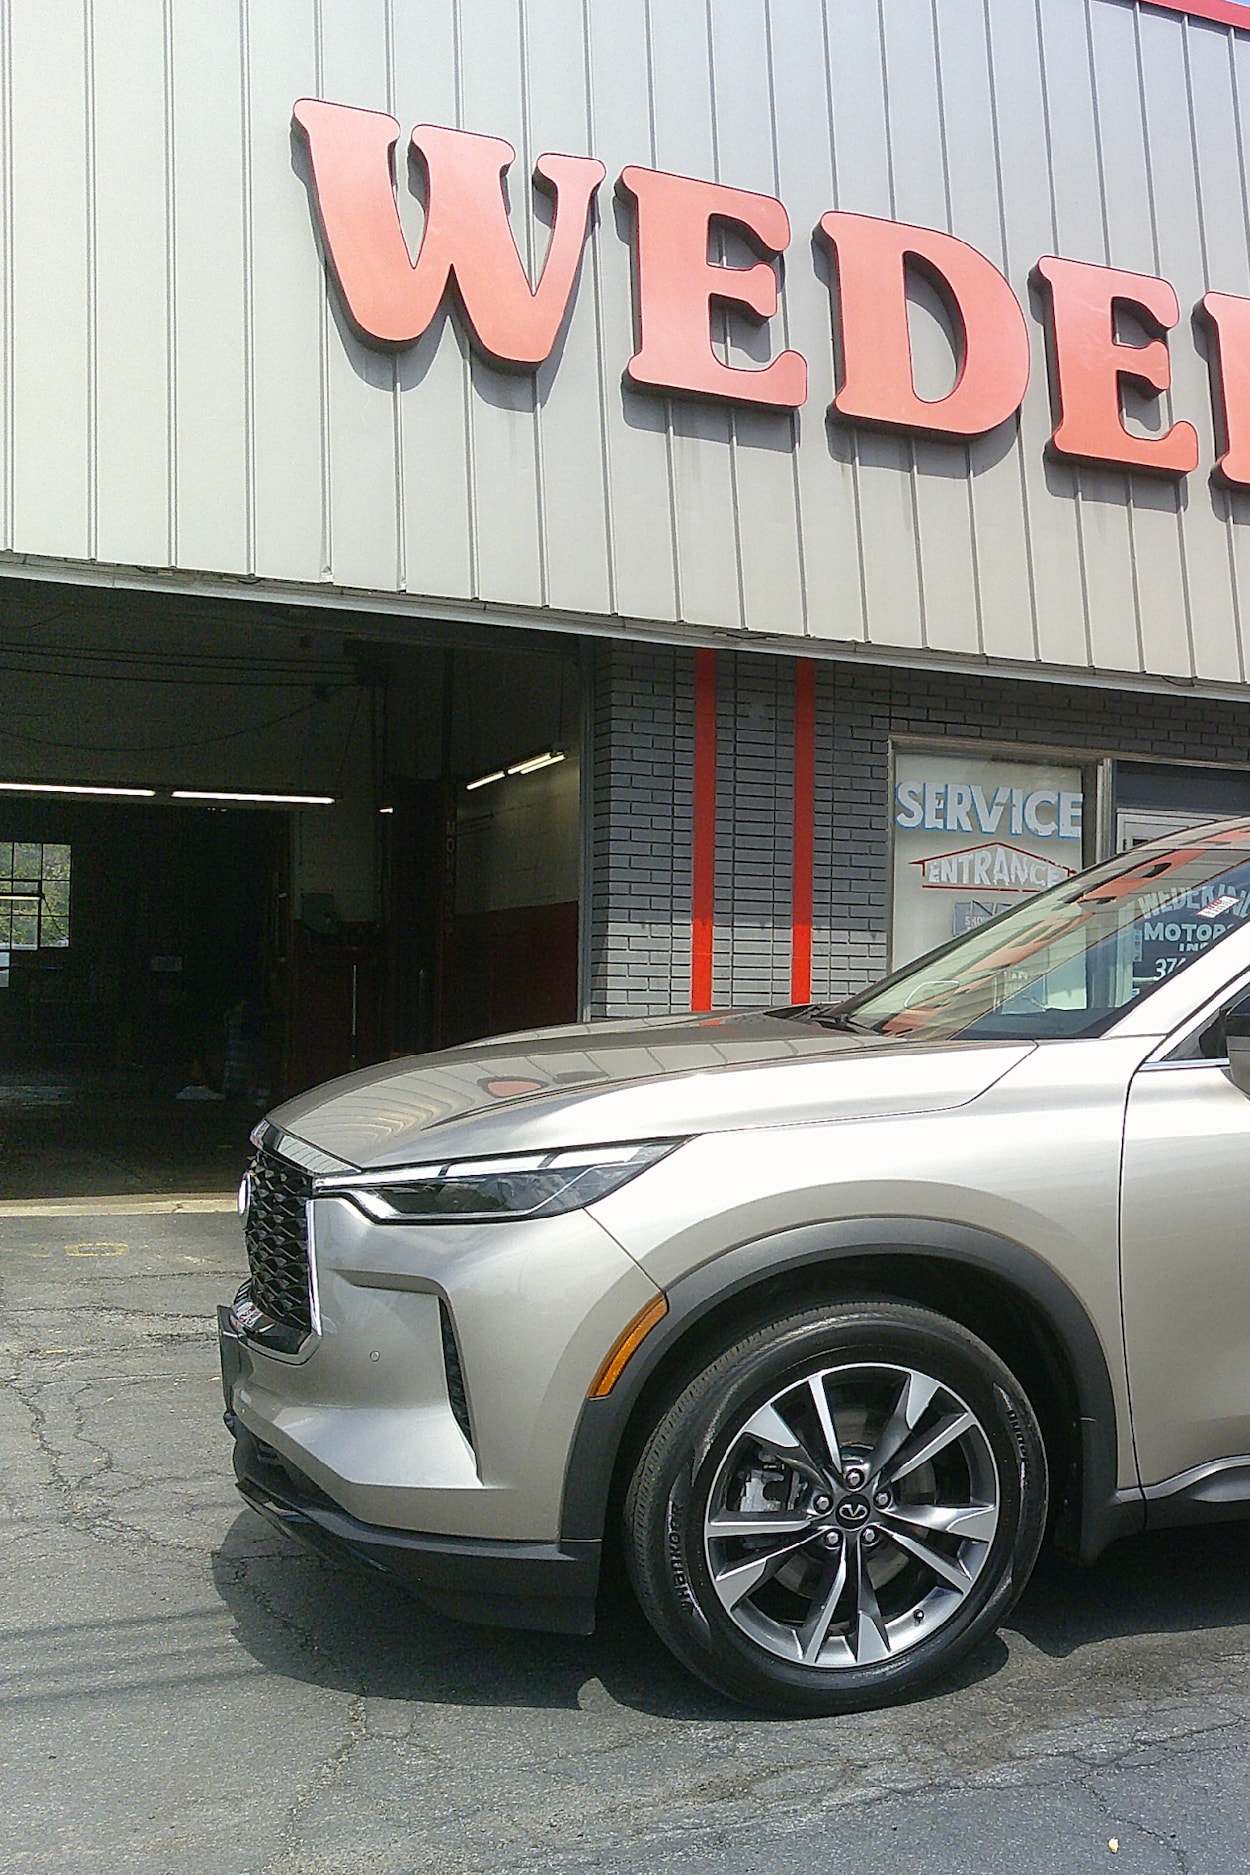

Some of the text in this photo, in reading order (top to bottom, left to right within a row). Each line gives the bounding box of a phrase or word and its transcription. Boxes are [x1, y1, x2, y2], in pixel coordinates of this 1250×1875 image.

[896, 781, 1083, 839] SERVICE
[928, 847, 1062, 887] ENTRANCE
[1144, 922, 1234, 941] MOTOR
